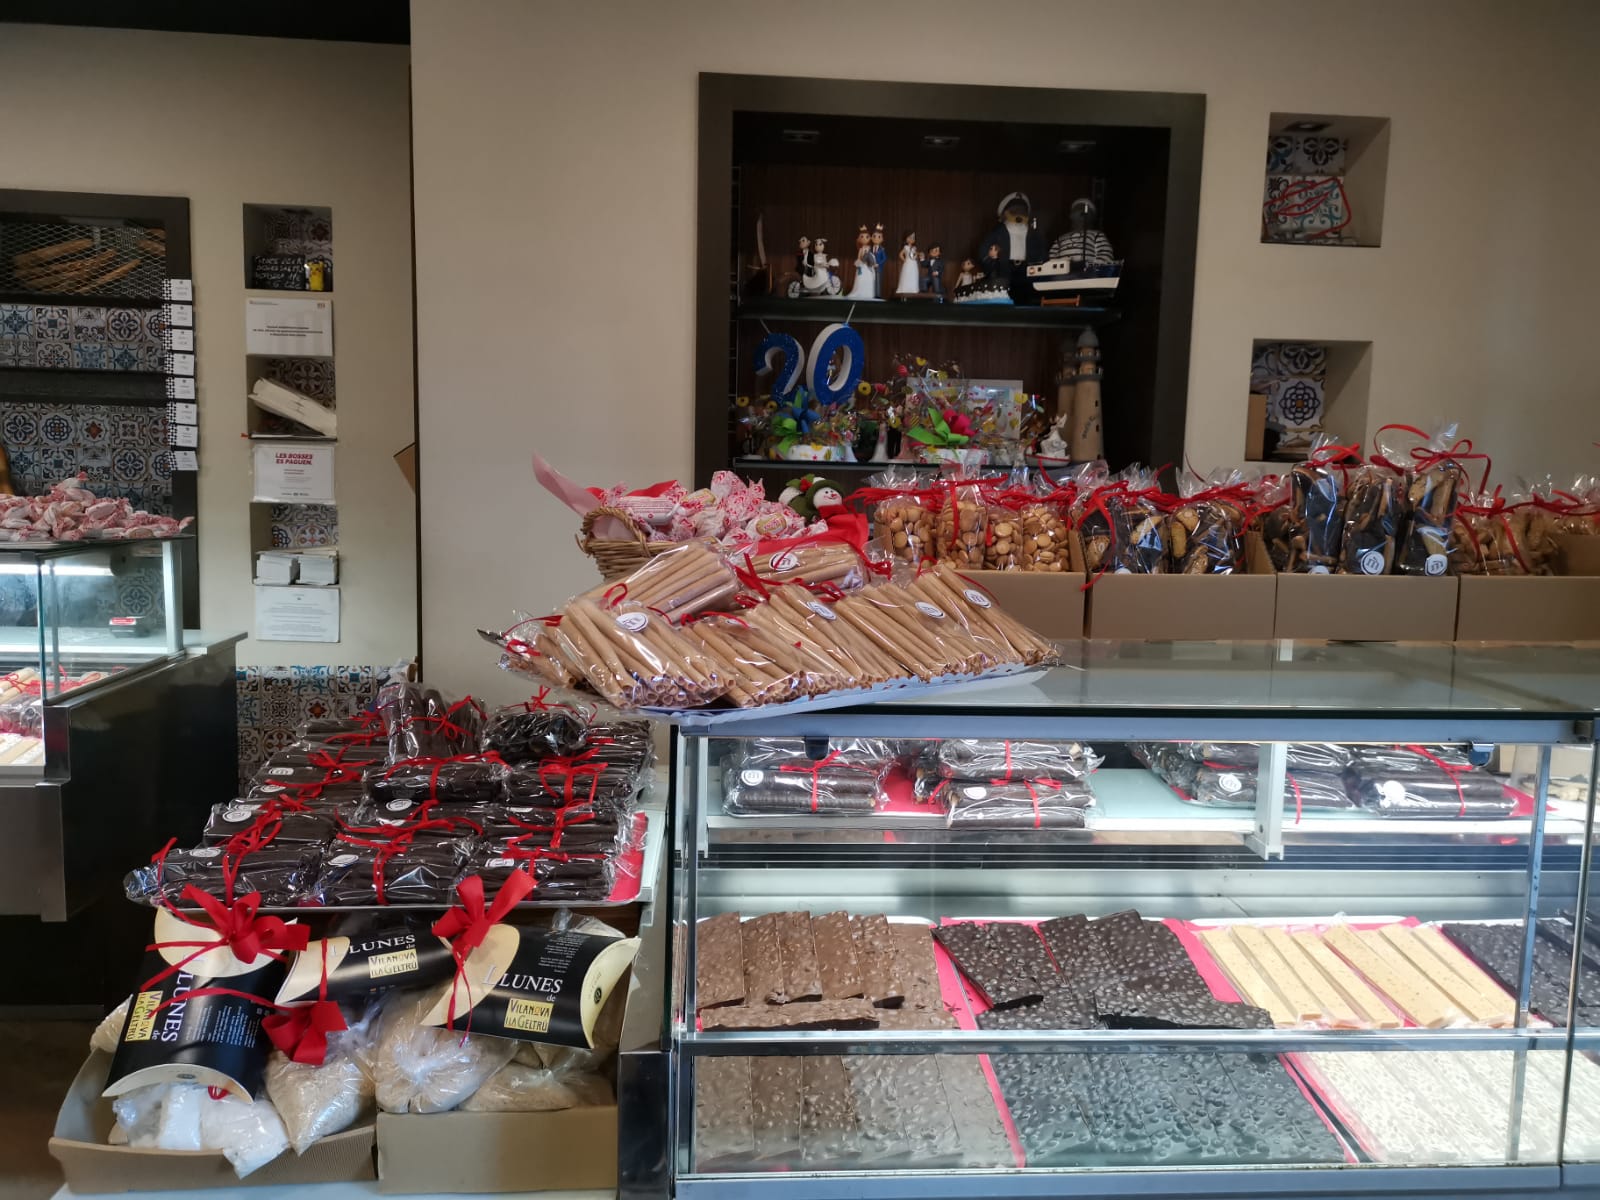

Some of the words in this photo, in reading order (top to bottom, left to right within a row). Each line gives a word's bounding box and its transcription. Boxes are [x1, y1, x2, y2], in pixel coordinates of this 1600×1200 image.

[370, 952, 416, 965] VILANOVA
[546, 993, 557, 1002] de
[510, 1000, 551, 1017] VILANOVA
